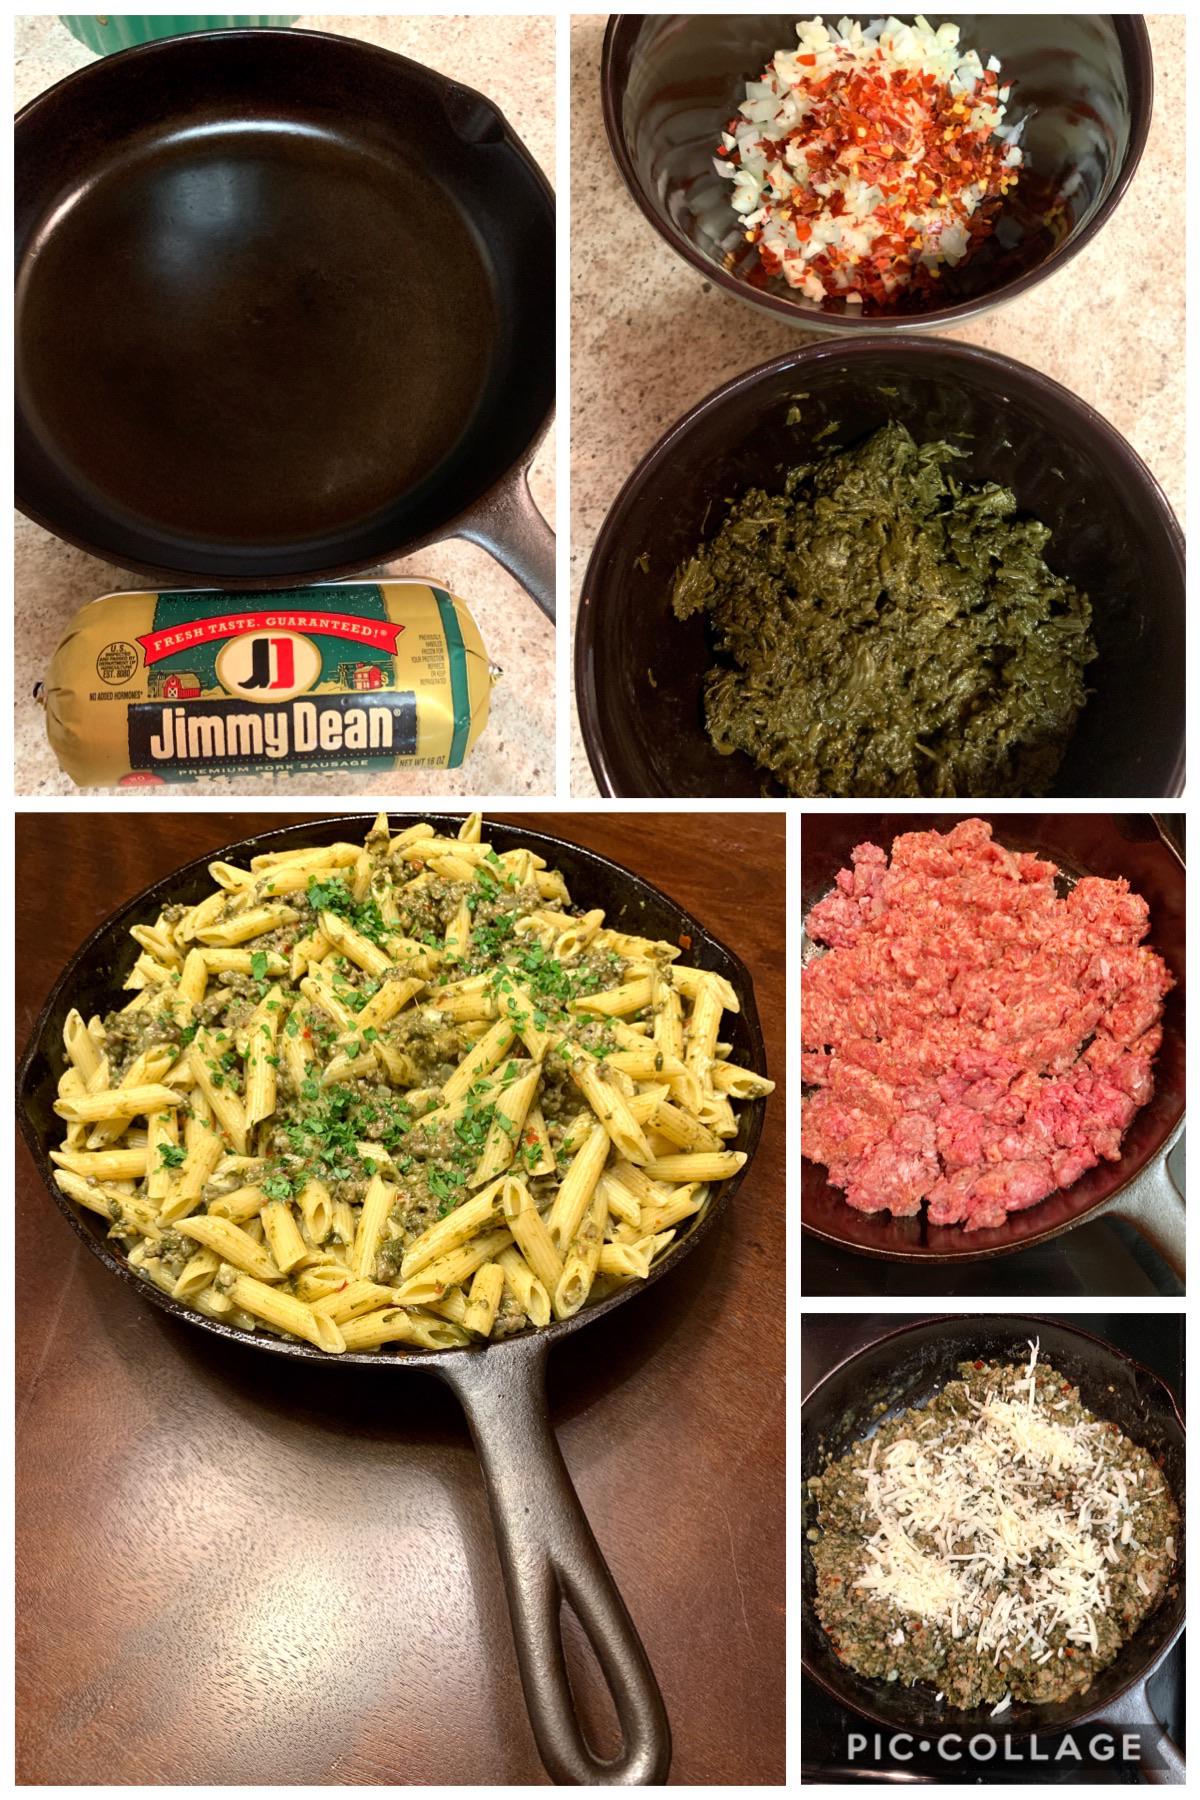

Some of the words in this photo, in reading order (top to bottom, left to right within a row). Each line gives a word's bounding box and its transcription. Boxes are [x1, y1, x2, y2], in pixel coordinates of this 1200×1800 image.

[154, 628, 204, 651] FRESH
[208, 618, 260, 634] TASTE.
[89, 692, 97, 701] NO
[97, 691, 113, 701] ADDED
[150, 707, 288, 759] Jimmy
[178, 767, 249, 776] PREMIUM
[255, 764, 294, 772] PORK
[300, 759, 369, 769] SAUSAGE
[400, 758, 413, 768] NET
[414, 757, 426, 767] WT
[427, 756, 436, 766] 16
[437, 755, 446, 765] OZ
